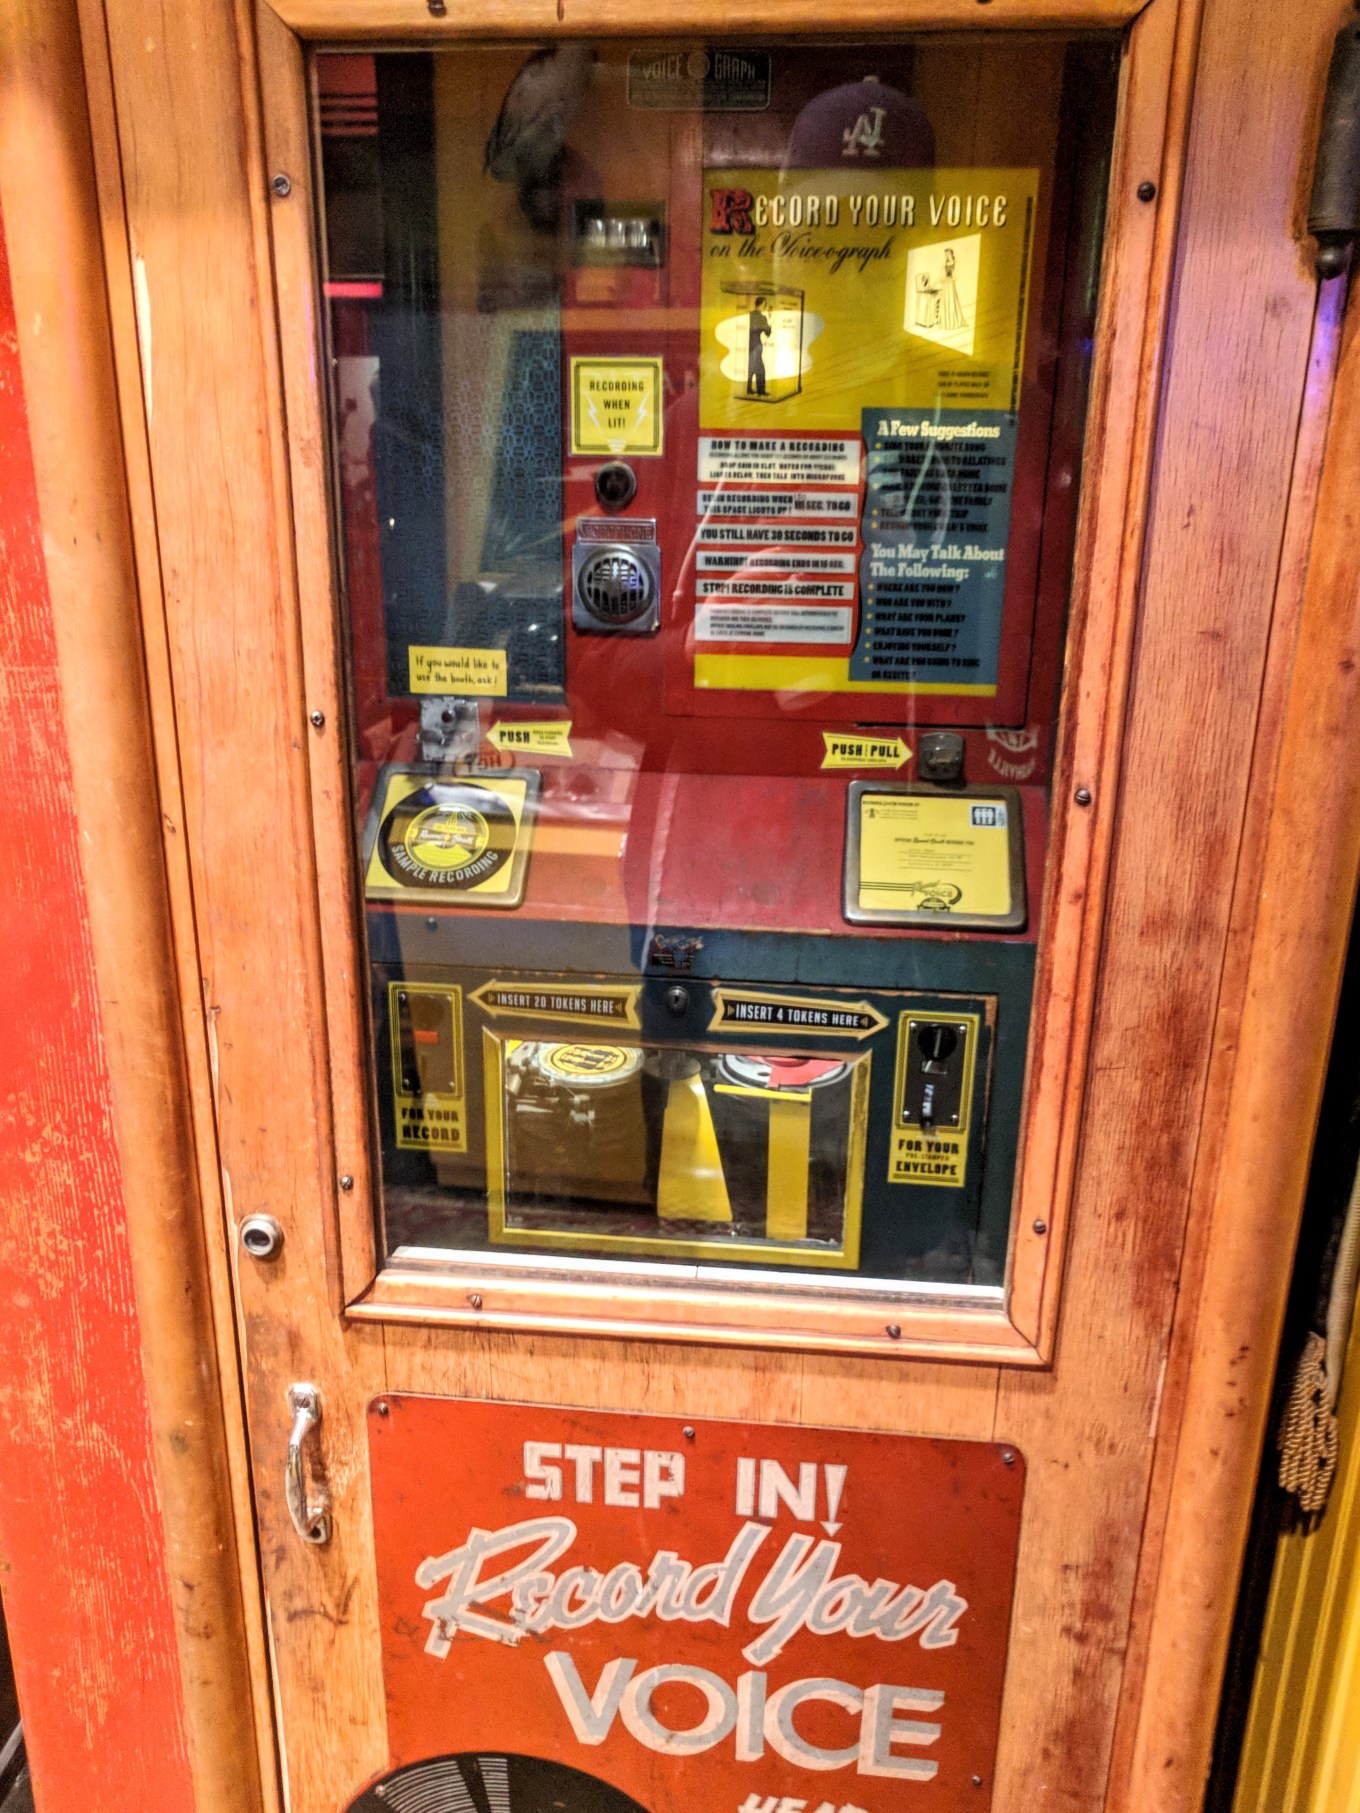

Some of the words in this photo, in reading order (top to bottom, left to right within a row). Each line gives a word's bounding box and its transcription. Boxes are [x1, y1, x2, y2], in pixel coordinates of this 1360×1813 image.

[709, 187, 839, 236] RECORD
[849, 194, 916, 228] YOUR
[929, 194, 1008, 228] VOICE
[709, 245, 731, 257] on
[738, 237, 765, 258] the
[589, 380, 645, 392] RECORDING
[603, 400, 631, 411] WHEN
[608, 418, 626, 429] LIT!
[876, 420, 889, 436] A
[889, 420, 919, 437] Few
[920, 420, 1001, 440] Suggestions
[711, 440, 731, 450] HOW
[735, 441, 746, 450] TO
[750, 441, 776, 450] MAKE
[780, 442, 786, 451] A
[702, 493, 725, 503] BEIN
[772, 495, 794, 504] WHEN
[704, 505, 721, 514] TIS
[701, 529, 718, 540] YOU
[719, 529, 745, 540] STILL
[746, 530, 769, 540] HAVE
[771, 530, 783, 541] 30
[784, 530, 827, 542] SECONDS
[828, 531, 840, 542] TO
[842, 532, 854, 542] GO
[871, 543, 895, 558] You
[898, 543, 929, 563] May
[931, 545, 961, 560] Talk
[963, 545, 1005, 560] About
[869, 561, 896, 577] The
[898, 562, 969, 582] Following:
[732, 583, 783, 594] RECORDING
[784, 584, 793, 595] IS
[794, 584, 844, 596] COMPLETE
[416, 655, 424, 667] If
[426, 660, 442, 673] you
[444, 656, 470, 668] would
[473, 657, 488, 669] like
[491, 660, 500, 670] to
[416, 674, 431, 682] use
[435, 672, 447, 683] the
[499, 730, 530, 743] PUSH
[832, 744, 863, 757] PUSH
[870, 745, 900, 758] PULL
[392, 844, 427, 880] SAMPLE
[429, 850, 499, 883] RECORDING
[497, 992, 530, 1008] INSERT
[550, 996, 587, 1012] TOKENS
[590, 999, 614, 1014] HERE
[735, 1003, 772, 1020] INSERT
[776, 1007, 784, 1021] 4
[788, 1009, 828, 1024] TOKENS
[831, 1012, 859, 1027] HERE
[401, 1107, 424, 1120] FOR
[427, 1109, 459, 1121] YOUR
[402, 1125, 460, 1141] RECORD
[898, 1139, 921, 1151] FOR
[927, 1140, 959, 1154] YOUR
[896, 1161, 957, 1175] ENVELOPE
[523, 1440, 686, 1510] STEP
[736, 1457, 849, 1537] IN!
[415, 1516, 773, 1660] Record
[742, 1533, 969, 1667] Your
[543, 1651, 946, 1782] VOICE
